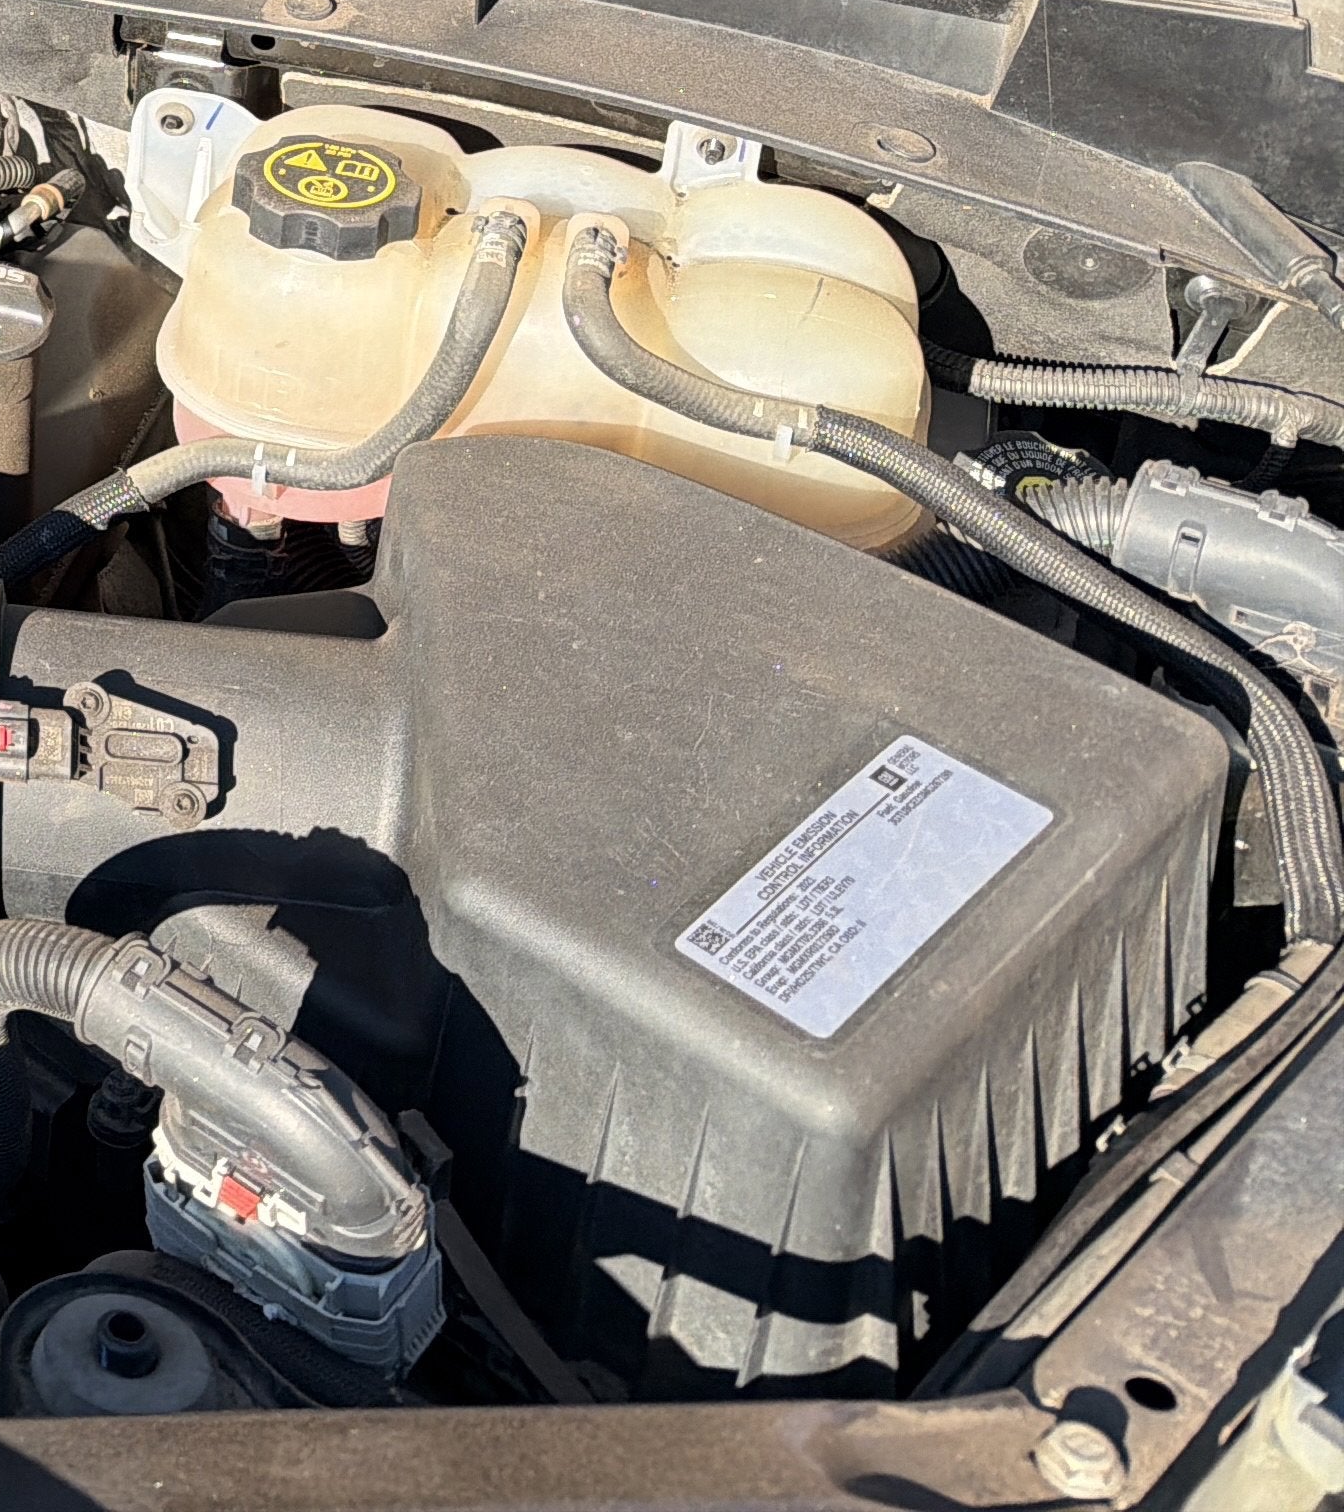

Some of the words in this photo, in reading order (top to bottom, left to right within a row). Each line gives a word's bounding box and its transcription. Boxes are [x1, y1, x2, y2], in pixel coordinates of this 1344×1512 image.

[1002, 441, 1014, 451] LE
[1015, 440, 1057, 455] BOUCHON
[1006, 451, 1020, 461] DU
[1020, 450, 1053, 463] LIQUIDE
[1055, 457, 1067, 468] DE
[1035, 460, 1063, 476] BIDON
[754, 846, 798, 883] VEHICLE
[790, 810, 837, 849] EMISSION
[755, 860, 804, 901] CONTROL
[796, 808, 860, 863] INFORMATION
[717, 932, 755, 965] Conforms
[795, 875, 817, 892] 2021
[729, 956, 750, 973] U.S.
[742, 943, 764, 960] EPA
[756, 927, 780, 947] class
[794, 894, 815, 911] LDT
[740, 947, 778, 980] California
[770, 932, 795, 952] class
[808, 900, 830, 916] LDT
[825, 939, 845, 955] CA
[752, 962, 783, 989] Group:
